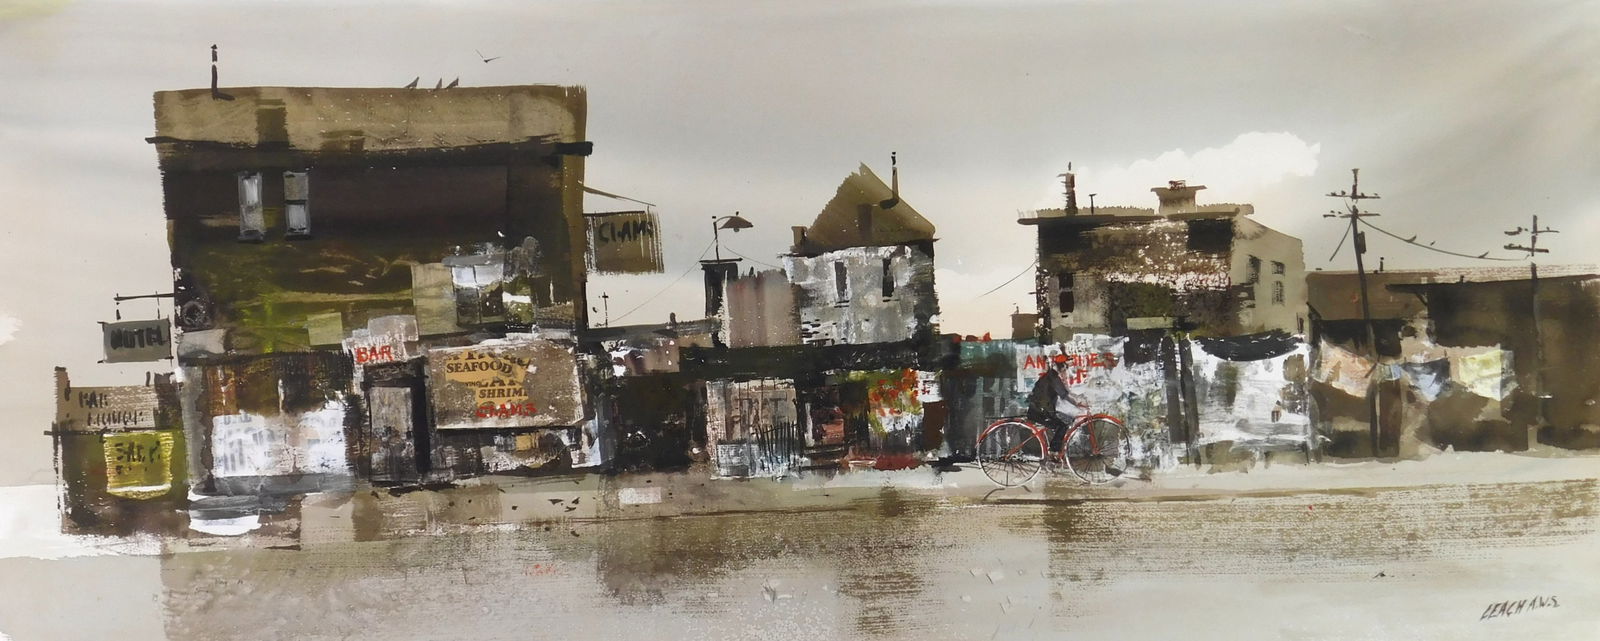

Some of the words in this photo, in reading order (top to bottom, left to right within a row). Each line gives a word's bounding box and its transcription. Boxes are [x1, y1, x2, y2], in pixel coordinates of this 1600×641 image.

[354, 345, 394, 363] BAR
[446, 360, 513, 374] SEAFOOD
[475, 402, 537, 418] CLAMS
[1480, 600, 1527, 621] LEACH
